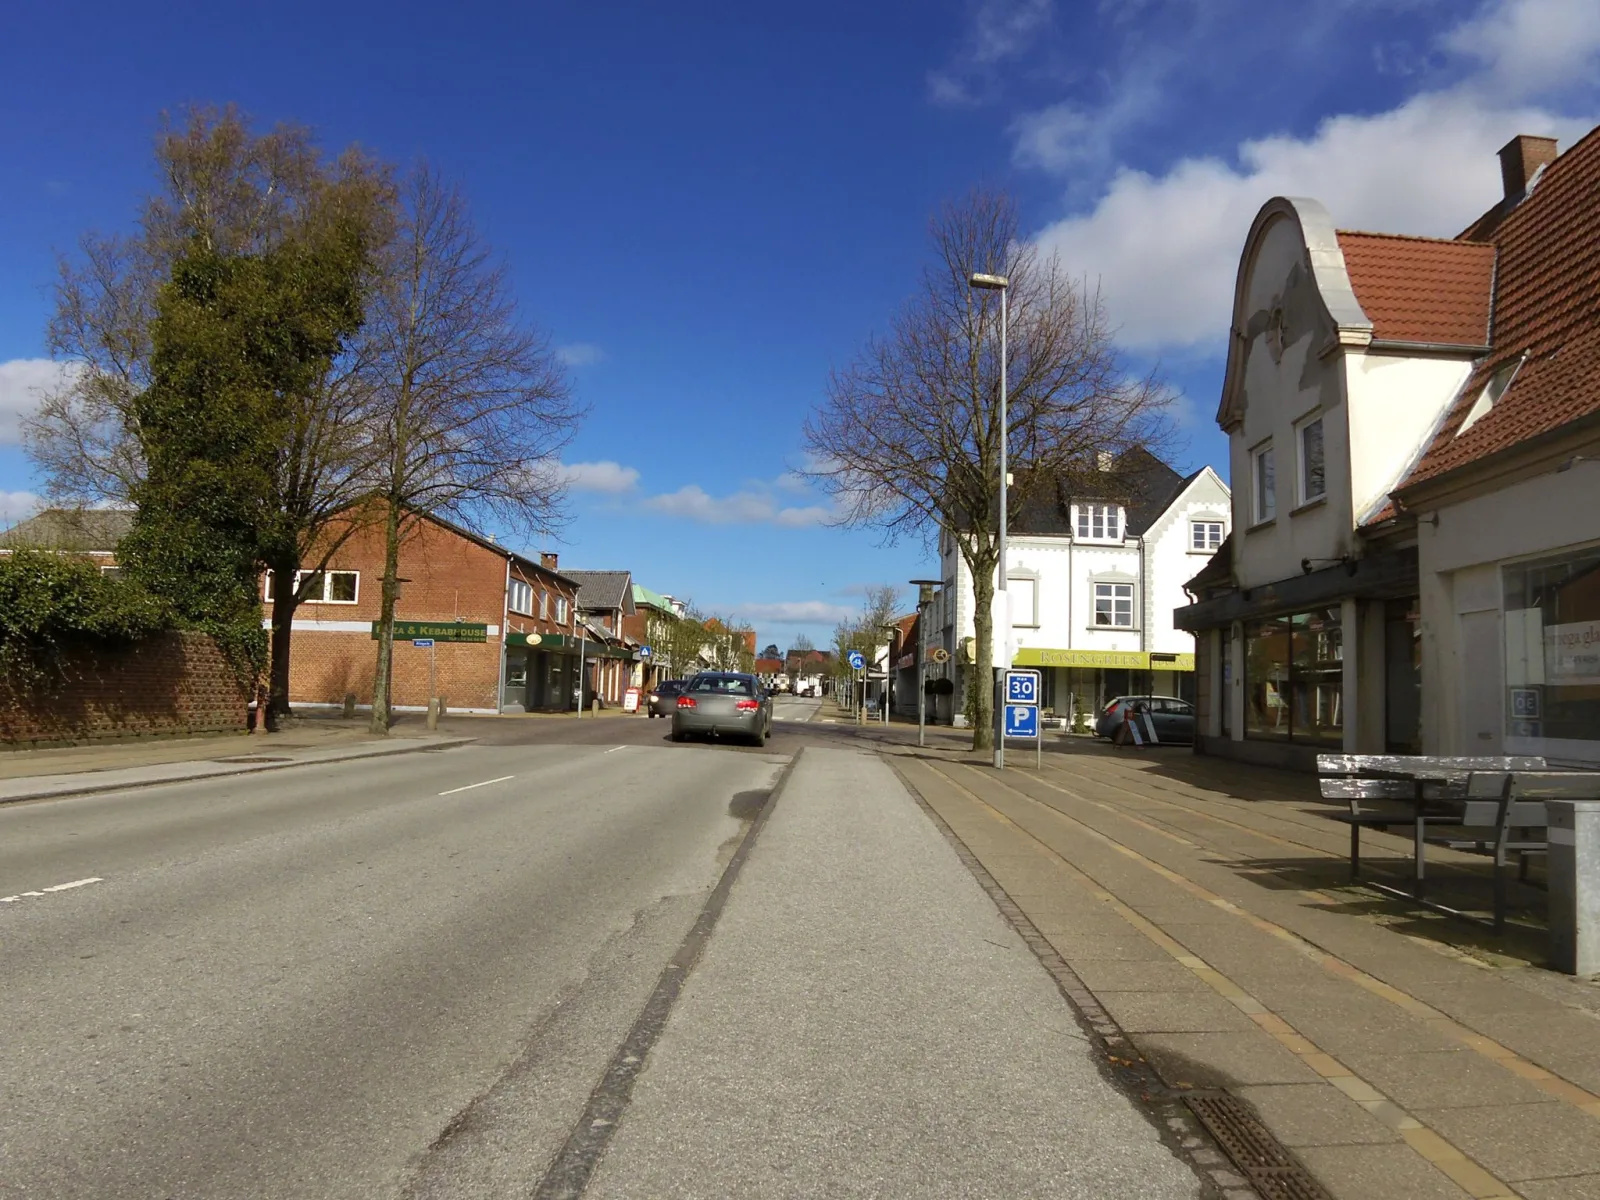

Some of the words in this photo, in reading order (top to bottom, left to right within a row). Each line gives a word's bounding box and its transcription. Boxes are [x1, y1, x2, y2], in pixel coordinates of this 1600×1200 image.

[407, 626, 416, 635] &
[420, 626, 486, 637] KEBABHOUSE
[1040, 651, 1141, 665] ROSENGREEN
[1011, 681, 1032, 694] 30
[1013, 707, 1030, 727] P
